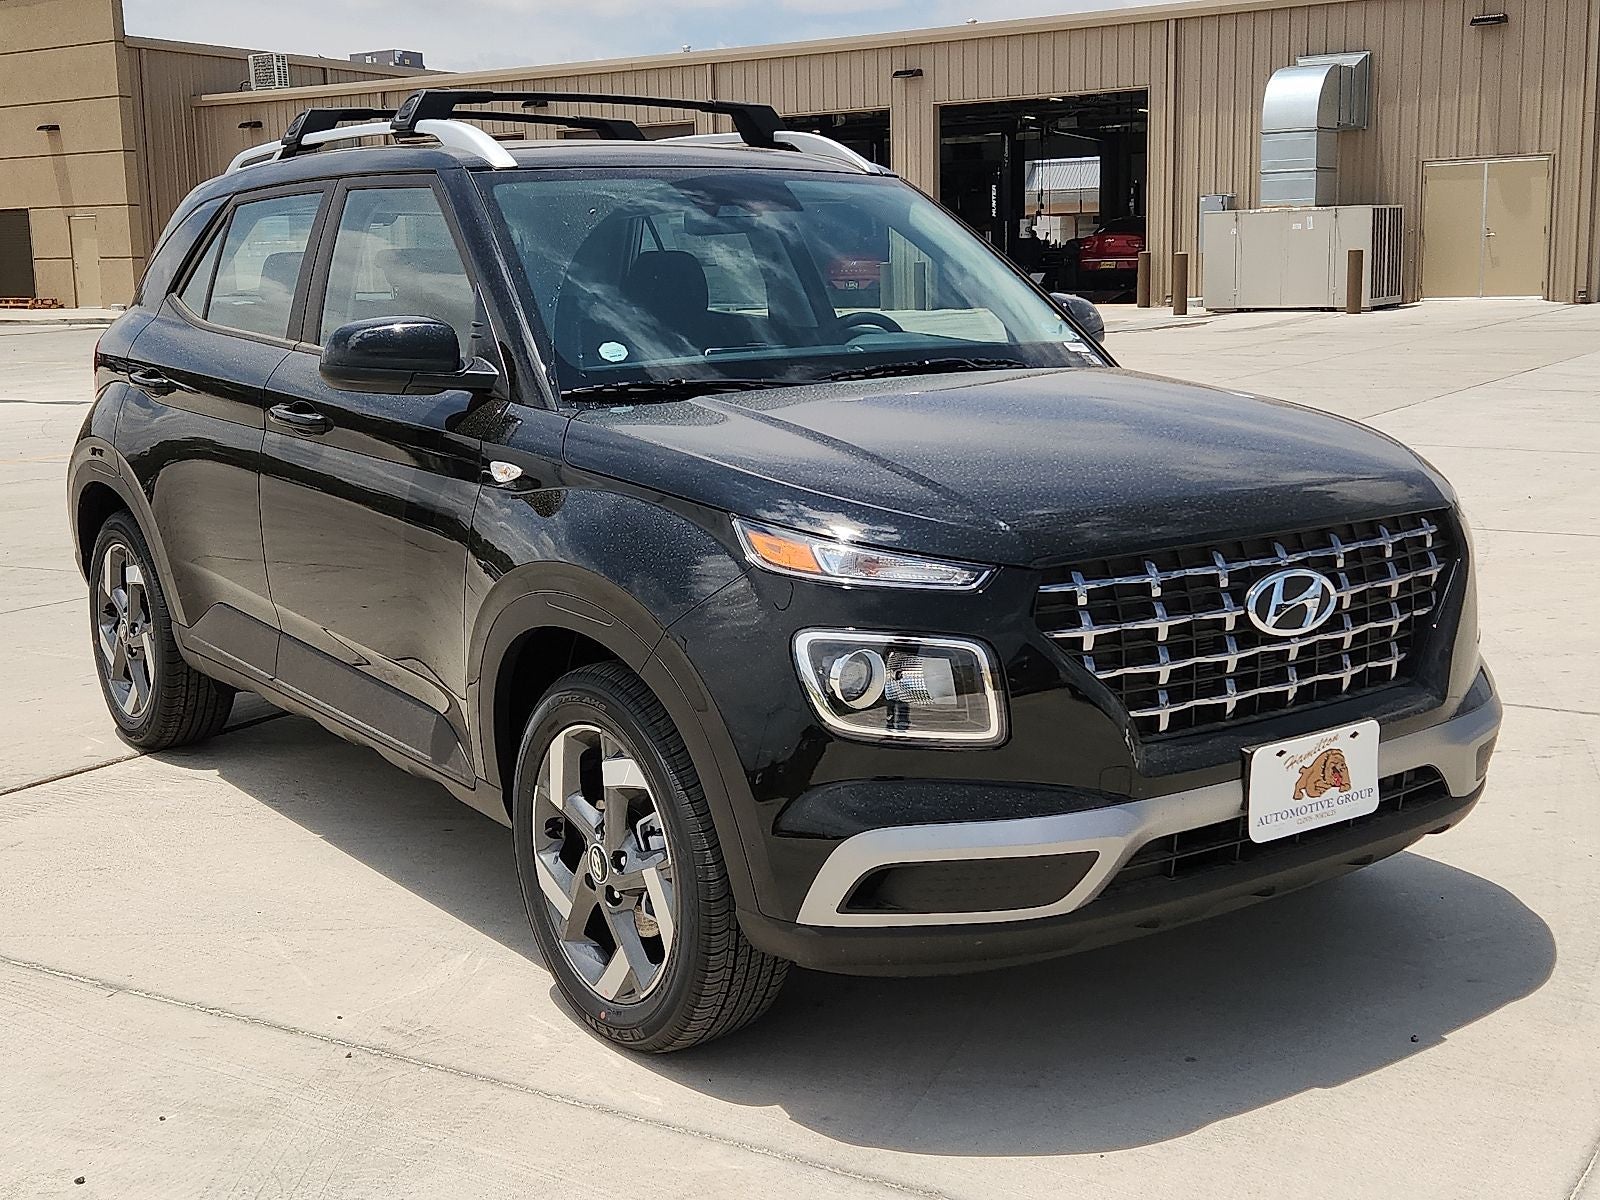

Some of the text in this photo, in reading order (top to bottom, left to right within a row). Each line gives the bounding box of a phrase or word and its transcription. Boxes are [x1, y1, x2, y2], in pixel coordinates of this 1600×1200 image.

[1284, 733, 1340, 771] Hamilton
[1257, 797, 1334, 828] AUTOMOTIVE
[1336, 787, 1374, 806] GROUP
